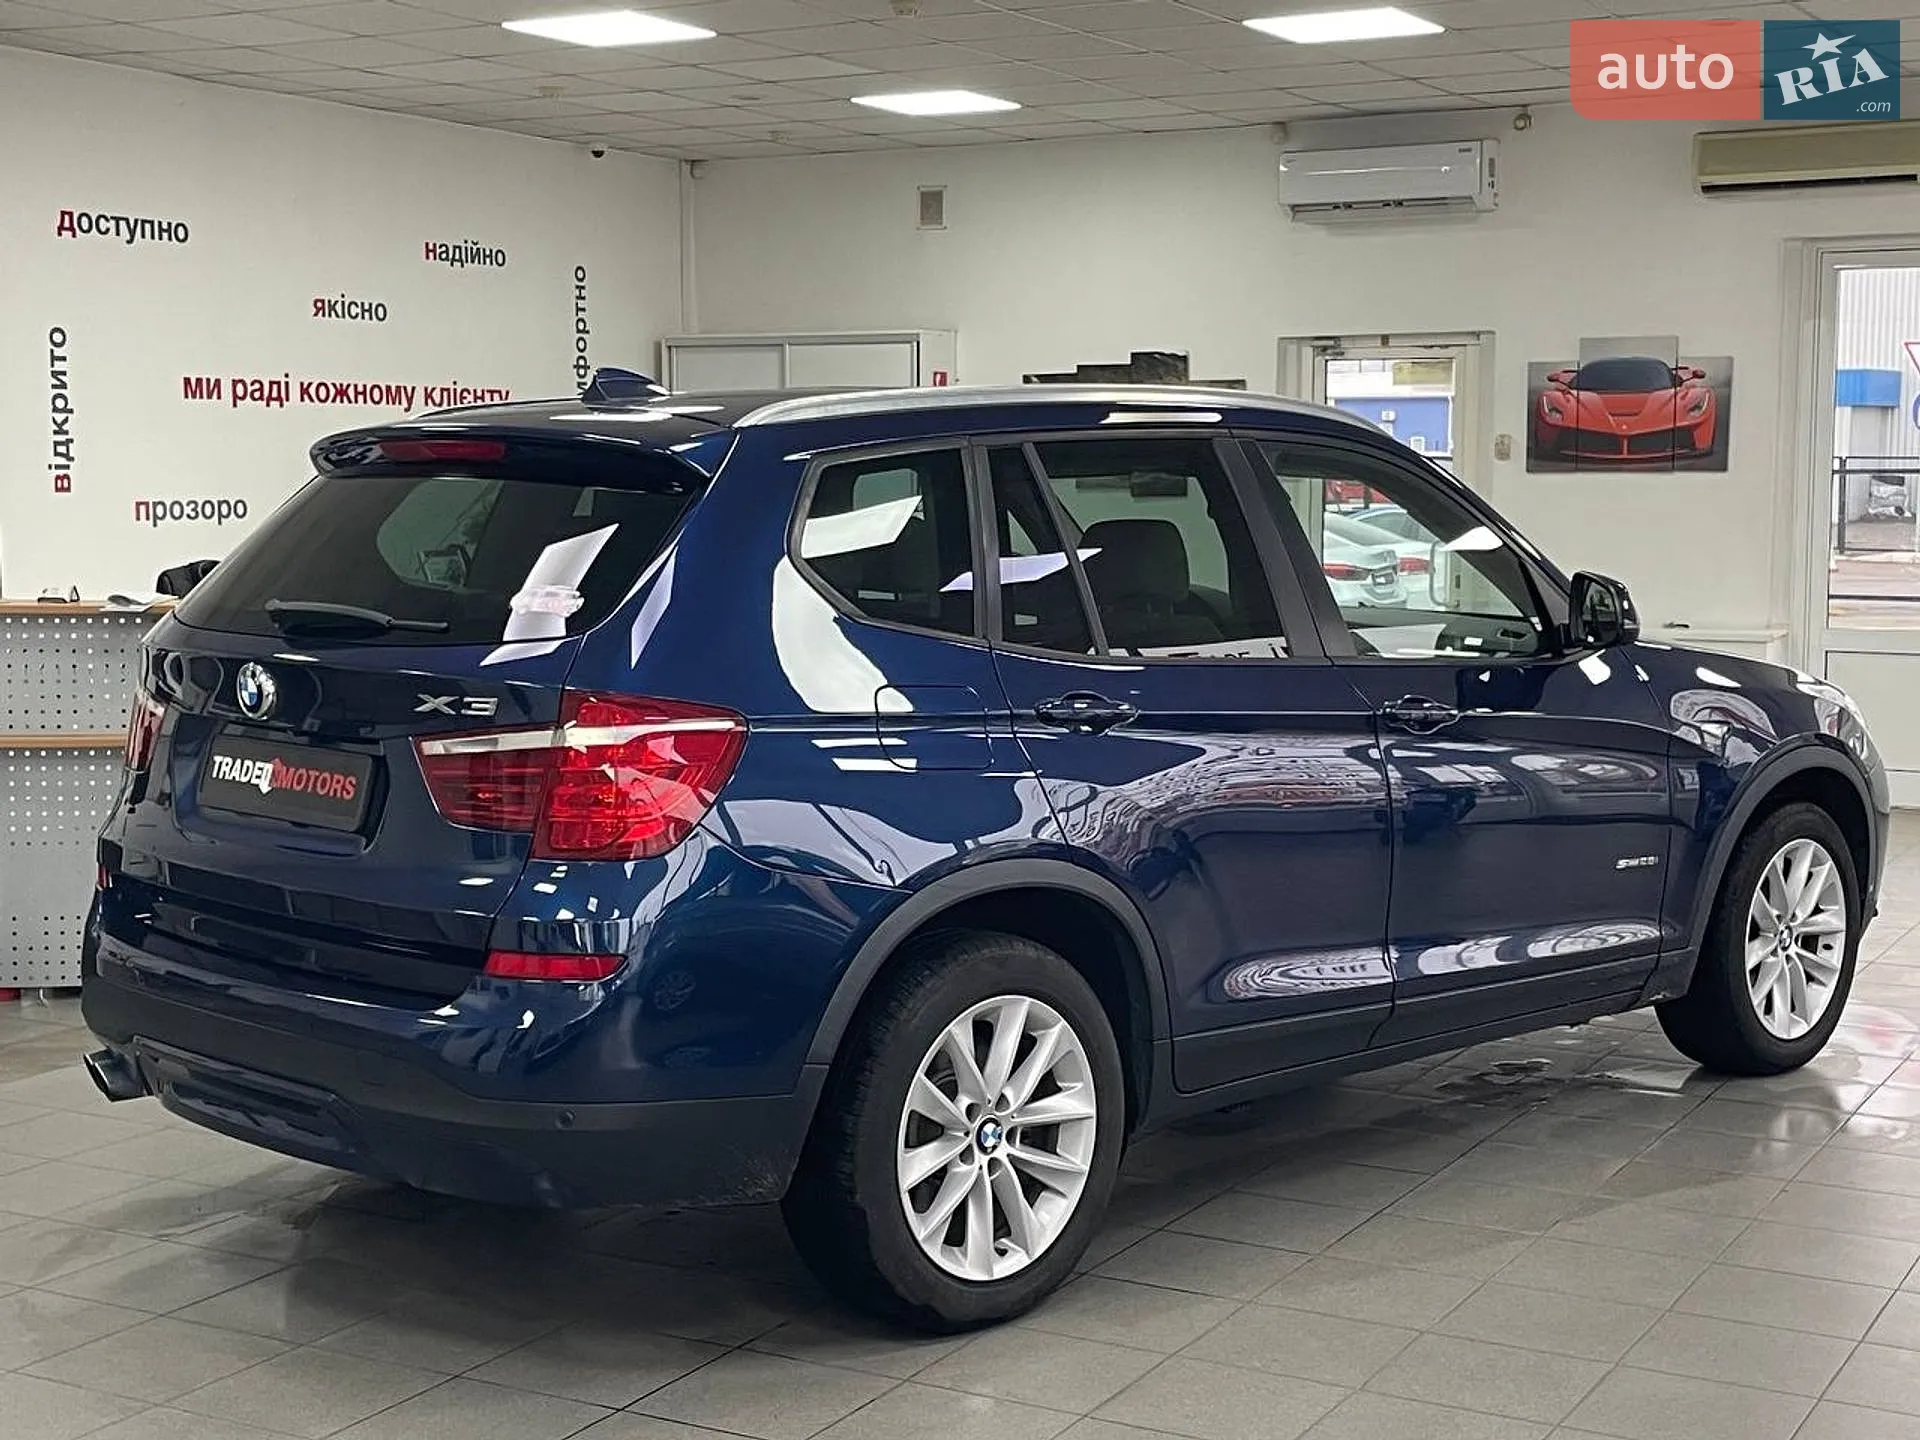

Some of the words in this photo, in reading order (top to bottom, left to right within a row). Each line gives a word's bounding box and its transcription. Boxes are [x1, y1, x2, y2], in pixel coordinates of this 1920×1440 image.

[57, 210, 189, 245] доступно
[424, 240, 506, 268] надійно
[312, 293, 388, 322] якісно
[182, 376, 222, 400] ми
[231, 372, 291, 408] раді
[299, 380, 417, 413] кожному
[47, 326, 75, 493] відкрито
[134, 498, 248, 529] прозоро
[413, 694, 498, 715] X3
[281, 766, 357, 800] MOTORS
